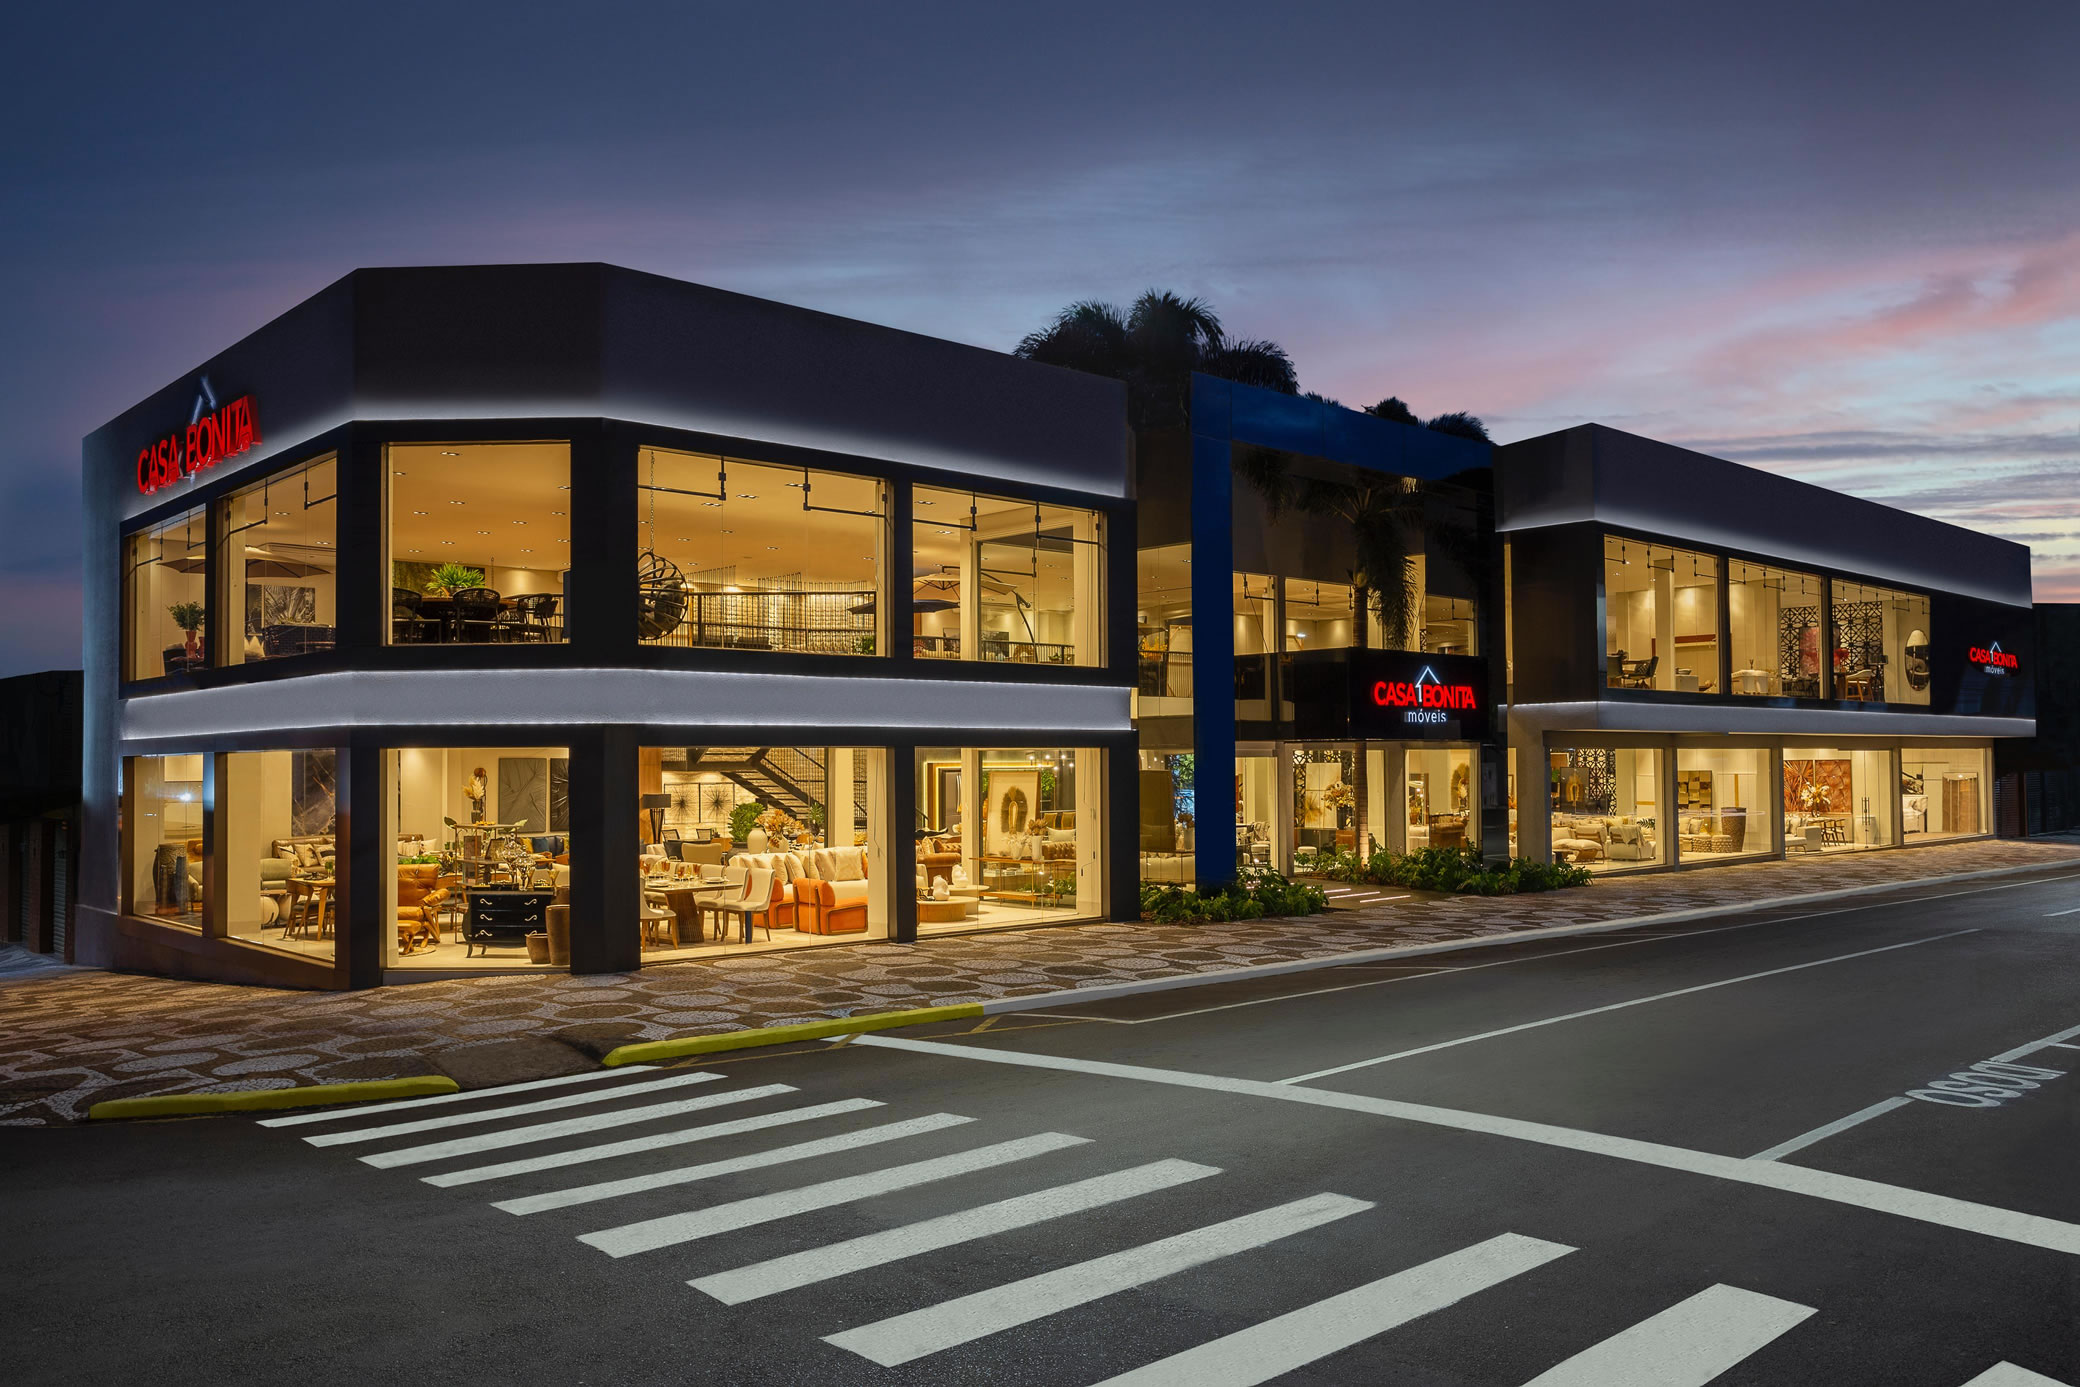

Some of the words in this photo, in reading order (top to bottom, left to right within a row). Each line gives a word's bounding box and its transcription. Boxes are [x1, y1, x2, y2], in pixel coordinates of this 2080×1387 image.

[137, 434, 180, 495] CASA
[186, 396, 256, 473] BONITA
[1969, 647, 1991, 664] CASA
[1993, 652, 2018, 669] BONITA
[1985, 665, 2005, 675] móveis
[1374, 681, 1418, 706] CASA
[1422, 684, 1476, 709] BONITA
[1407, 708, 1447, 722] móveis
[1905, 1060, 2067, 1108] IDOSO
